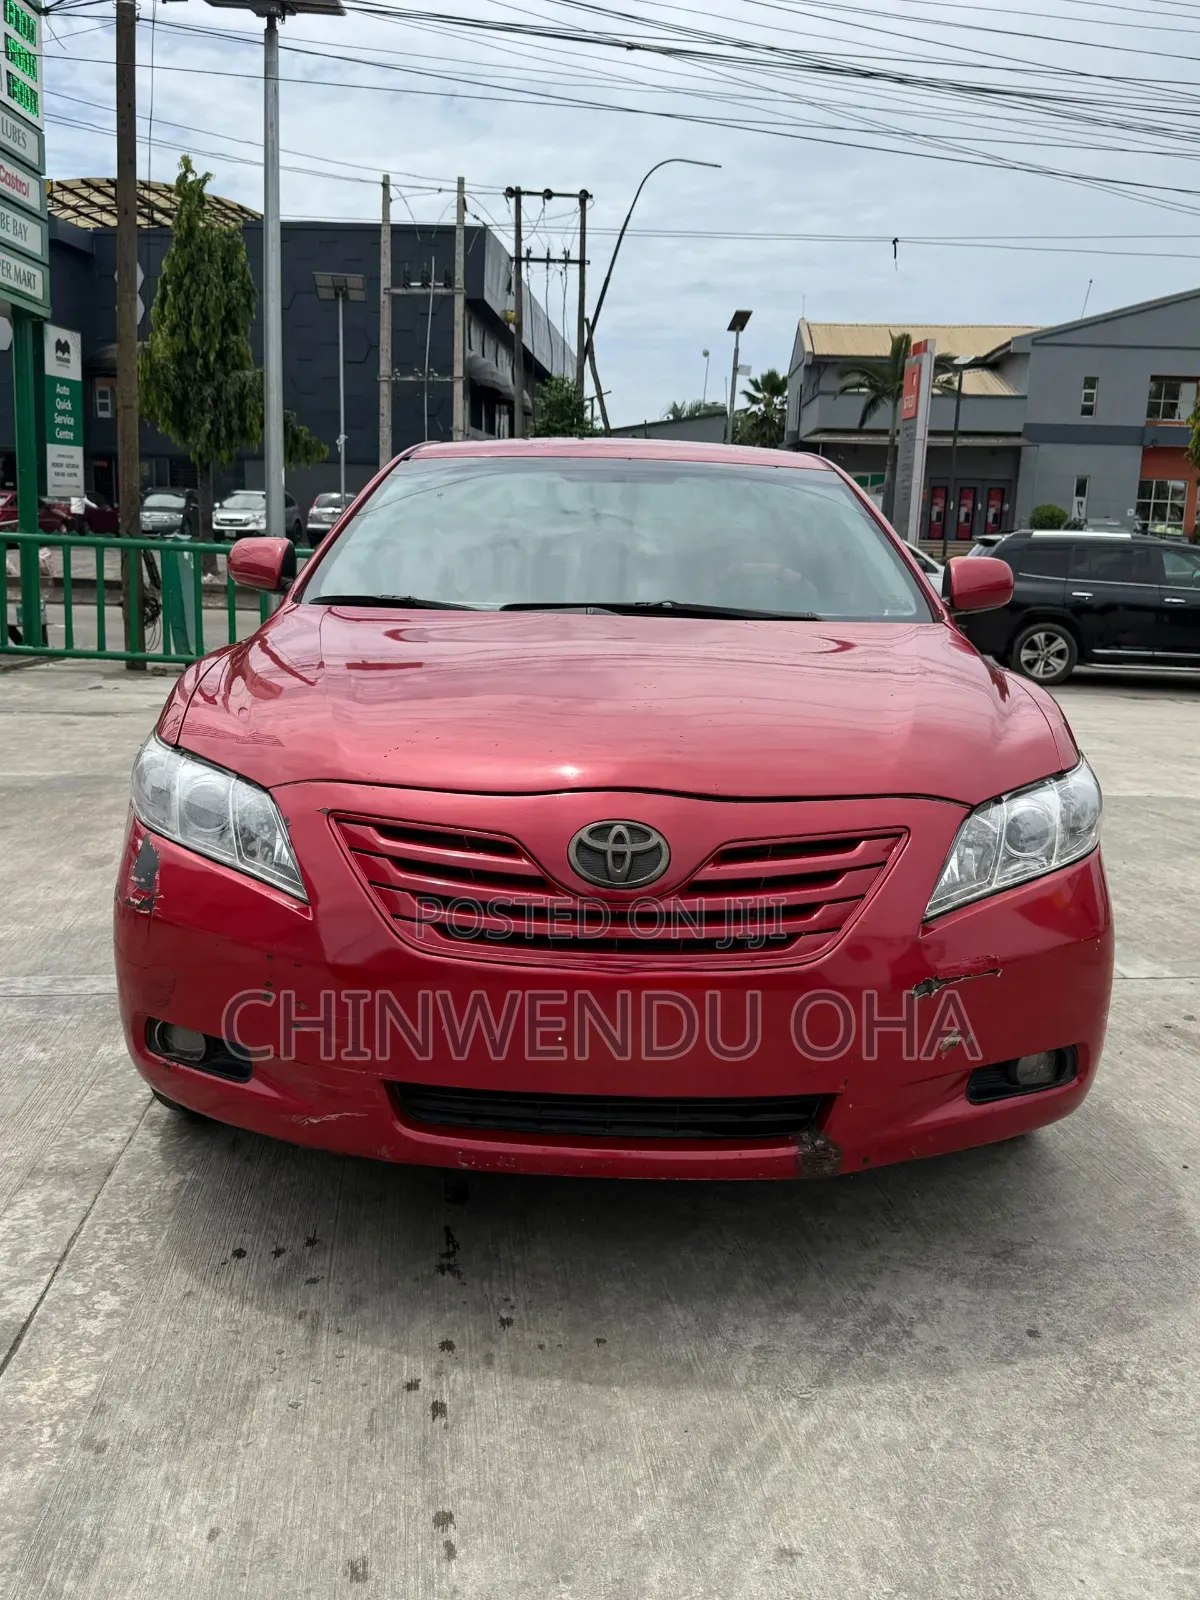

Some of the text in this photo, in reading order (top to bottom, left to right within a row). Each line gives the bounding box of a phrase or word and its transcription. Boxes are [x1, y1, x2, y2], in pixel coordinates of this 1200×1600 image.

[1, 116, 27, 150] LUBES
[0, 164, 30, 198] Castrol
[12, 218, 28, 242] BAY
[14, 264, 37, 290] MART
[56, 383, 70, 395] Auto
[55, 398, 72, 411] Quick
[54, 412, 75, 426] Service
[55, 428, 74, 440] Centre
